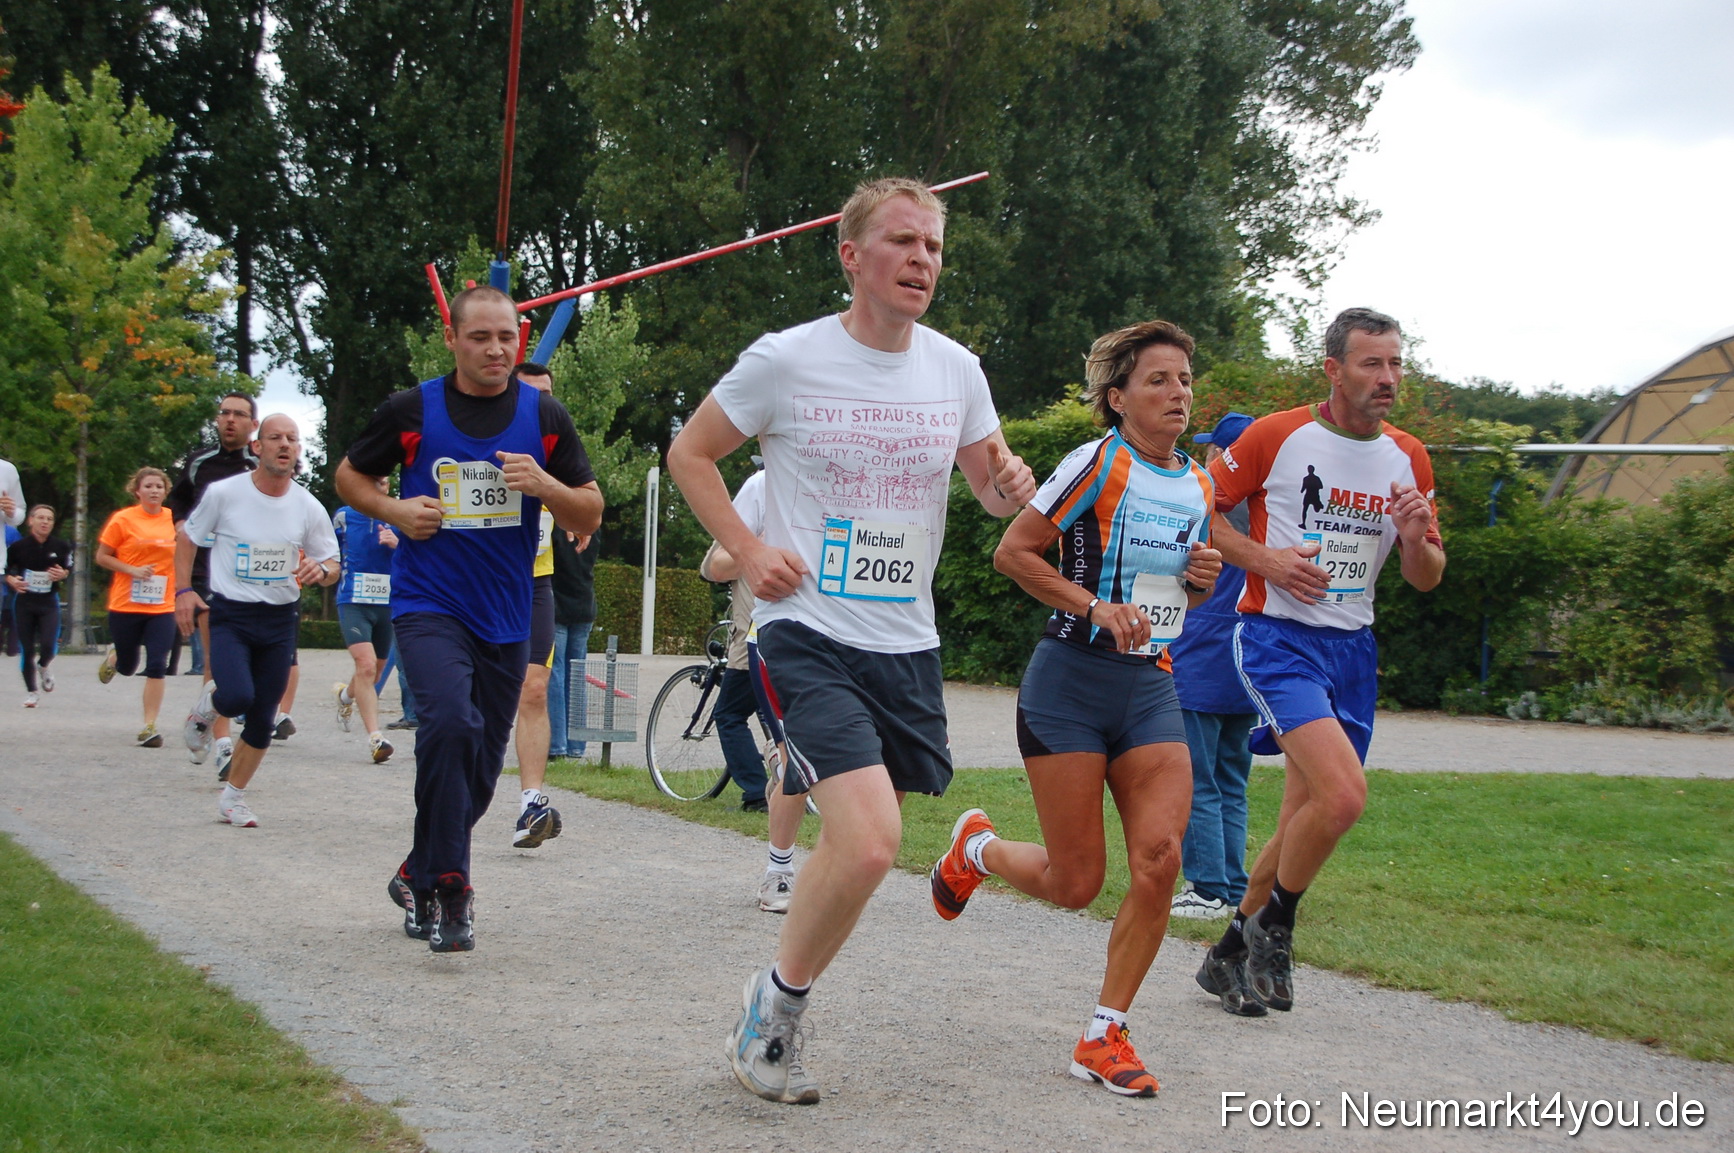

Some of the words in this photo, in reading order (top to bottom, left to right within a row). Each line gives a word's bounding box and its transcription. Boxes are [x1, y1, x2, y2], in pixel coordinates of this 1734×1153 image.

[803, 407, 843, 423] LEVI
[851, 408, 926, 426] STRAUSS
[929, 414, 940, 427] &
[868, 425, 912, 434] FRANCISCO
[813, 432, 892, 452] ORIGINAL
[898, 435, 956, 449] RIVETED
[800, 447, 849, 459] QUALITY
[462, 467, 500, 483] Nikolay
[471, 487, 508, 507] 363
[1330, 487, 1392, 516] MERZ
[1131, 511, 1189, 530] SPEED
[1323, 498, 1383, 524] Reisen
[1314, 519, 1352, 534] TEAM
[1354, 525, 1383, 537] 2008
[856, 528, 905, 550] Michael
[1130, 537, 1178, 552] RACING
[1326, 539, 1359, 554] Roland
[253, 560, 286, 572] 2427
[827, 552, 835, 565] A
[853, 556, 915, 584] 2062
[1325, 560, 1367, 579] 2790
[365, 584, 388, 594] 2035
